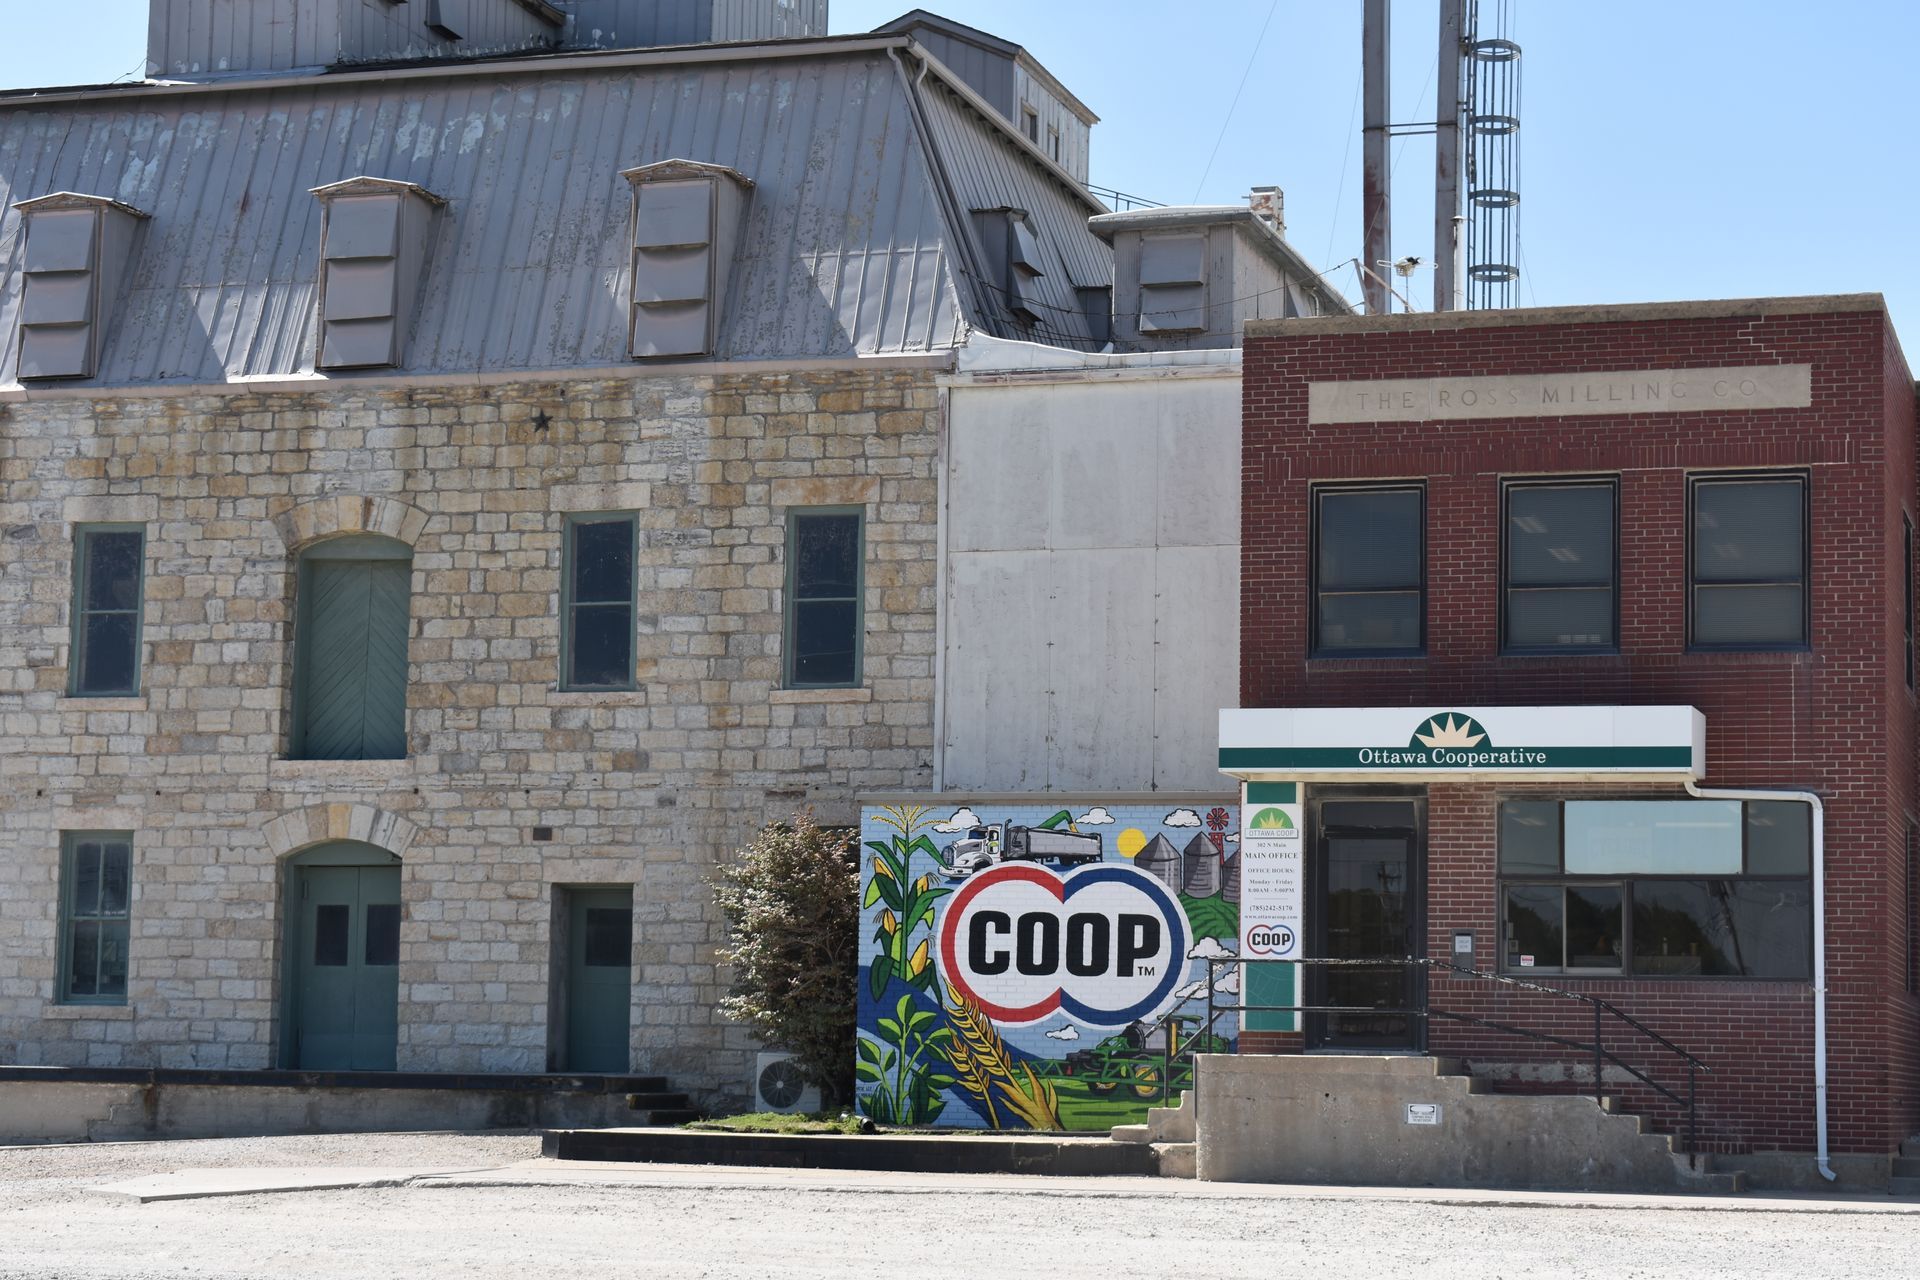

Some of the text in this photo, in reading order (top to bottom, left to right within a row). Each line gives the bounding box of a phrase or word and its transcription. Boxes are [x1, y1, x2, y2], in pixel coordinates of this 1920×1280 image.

[1356, 379, 1757, 410] THE ROSS MILLING CO
[1358, 748, 1546, 767] Ottawa Cooperative
[968, 909, 1161, 978] COOP
[1252, 933, 1290, 946] COOP
[1137, 966, 1155, 977] TM
